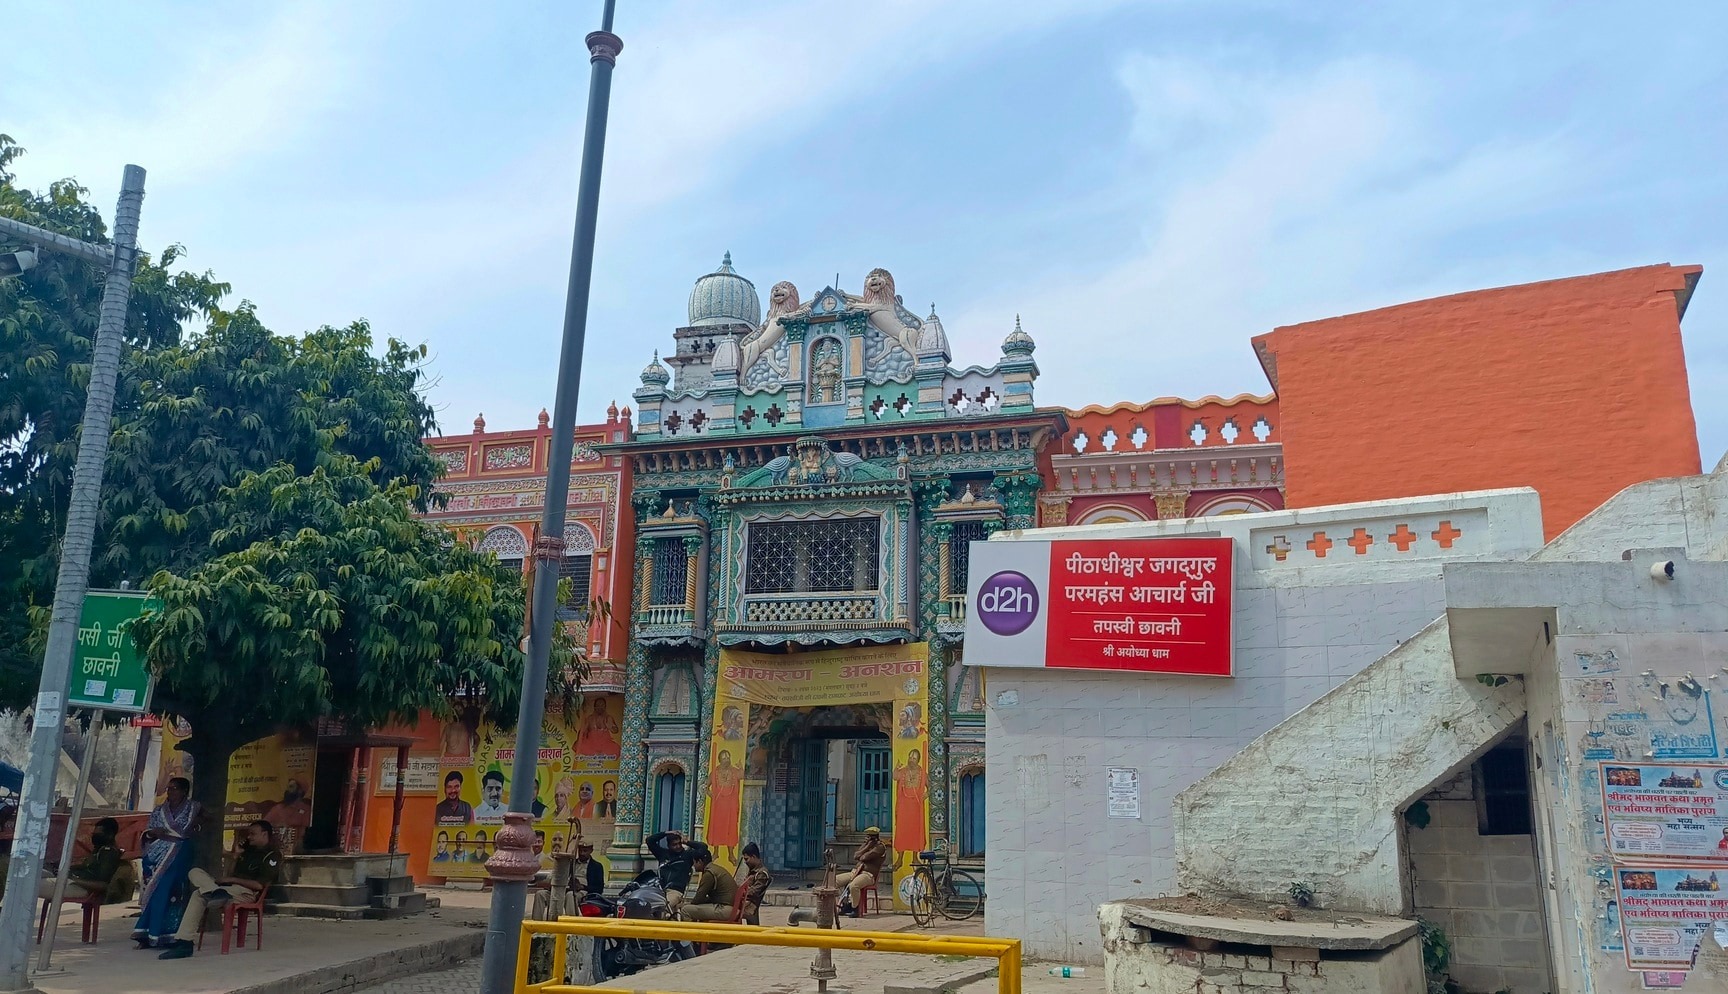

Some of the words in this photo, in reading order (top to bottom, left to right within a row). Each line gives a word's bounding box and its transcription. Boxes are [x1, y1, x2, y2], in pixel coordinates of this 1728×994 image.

[1066, 551, 1144, 577] पीठाधीश्वर
[1149, 556, 1217, 580] जगद्गुरु
[981, 587, 1032, 612] d2h
[1065, 581, 1124, 605] परमहंस
[1129, 581, 1186, 604] आचार्य
[1191, 581, 1215, 604] जी
[1093, 616, 1135, 635] तपस्वी
[1138, 617, 1181, 636] छावनी
[107, 622, 125, 648] जी
[1102, 644, 1115, 657] श्री
[1117, 645, 1149, 658] अयोध्या
[1151, 647, 1169, 659] धाम
[83, 651, 120, 677] छावनी
[724, 665, 813, 683] आमरण
[839, 660, 924, 679] अनशन
[495, 749, 515, 760] आमर
[538, 748, 562, 760] नशन
[1635, 794, 1667, 802] भागवत
[1669, 795, 1689, 803] कथा
[1693, 796, 1714, 805] अमृत
[1624, 803, 1652, 813] भविष्य
[1655, 804, 1689, 814] मालिका
[1691, 807, 1716, 817] पुराण
[1683, 822, 1705, 830] सत्संग
[1651, 899, 1683, 907] भागवत
[1686, 899, 1706, 907] कथा
[1640, 908, 1669, 918] भविष्य
[1672, 909, 1706, 918] मालिका
